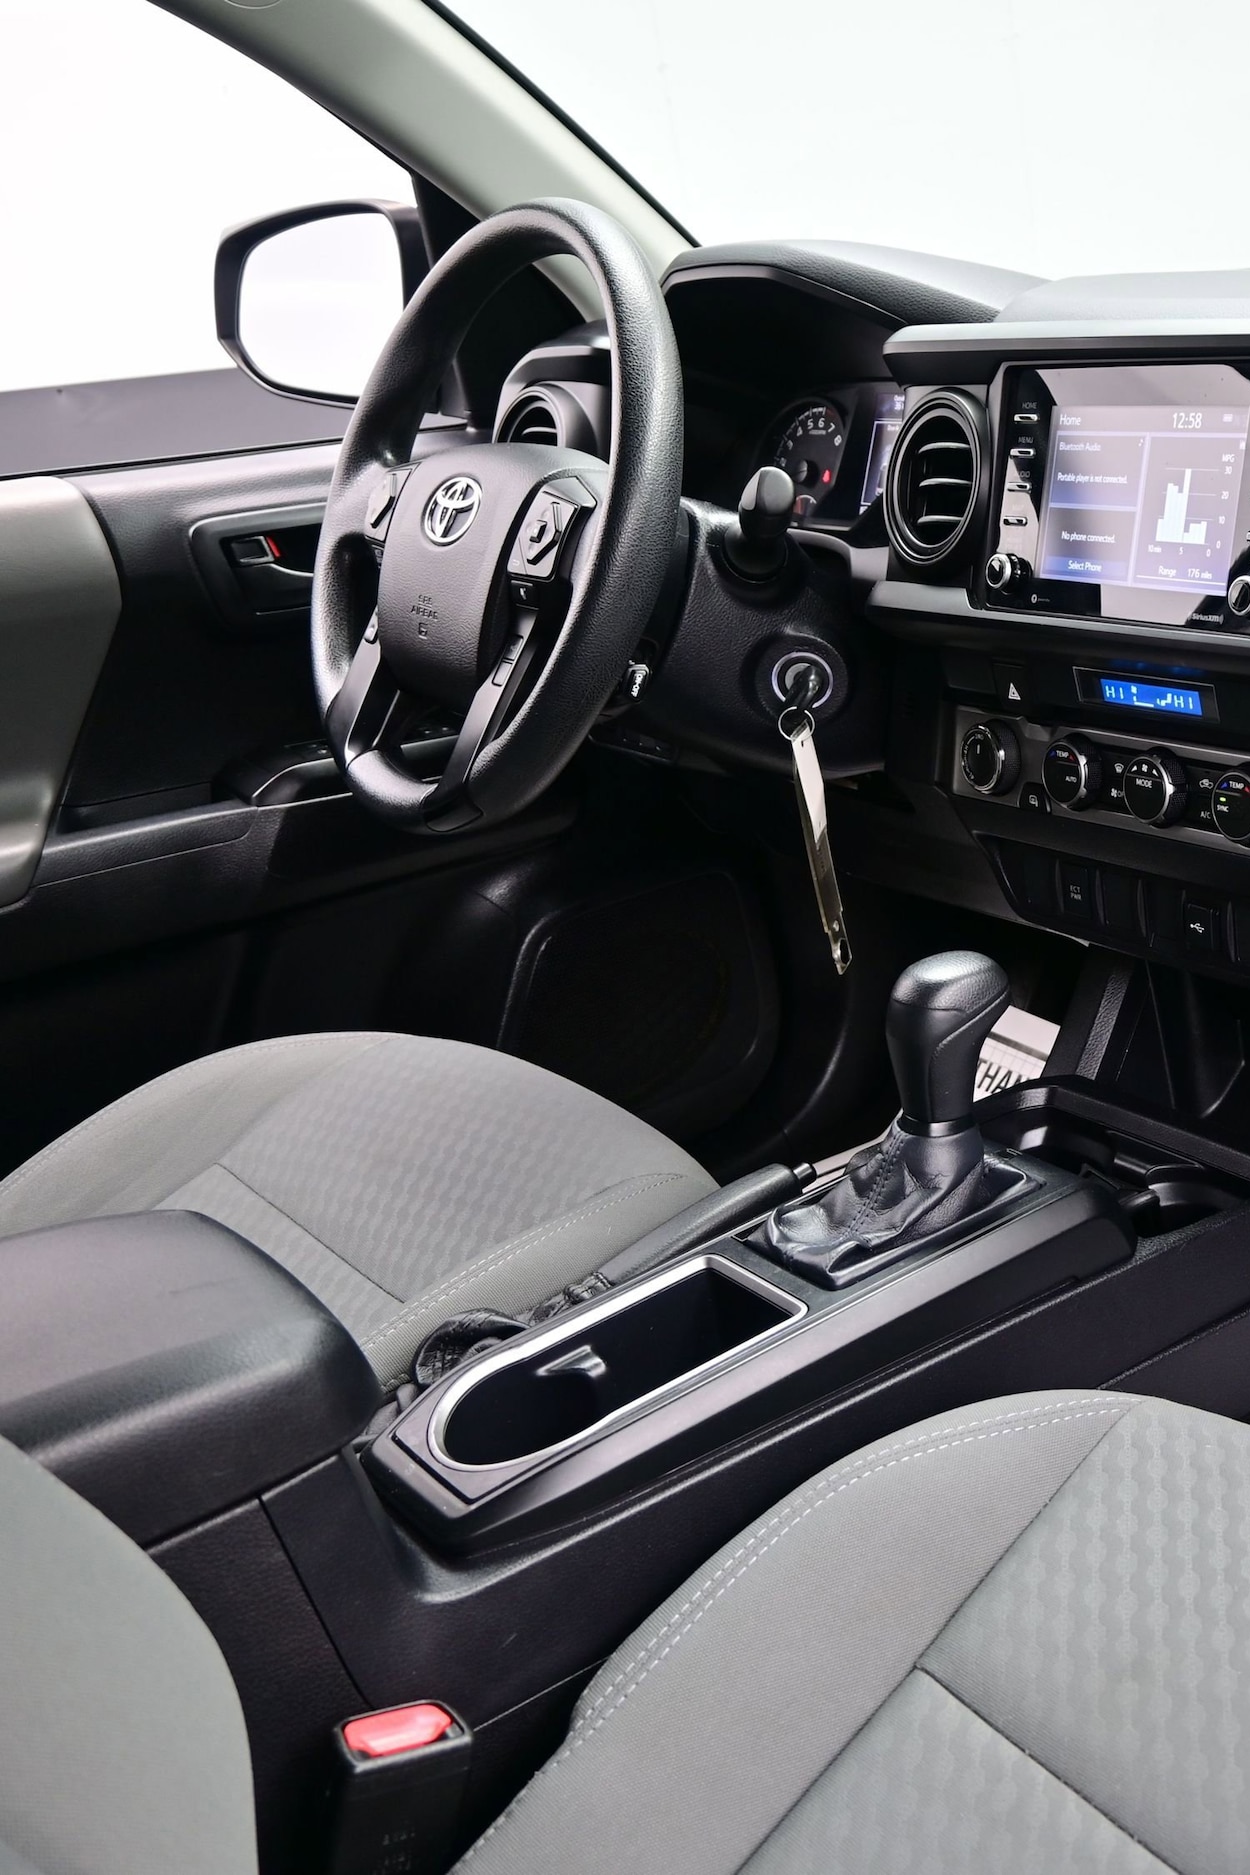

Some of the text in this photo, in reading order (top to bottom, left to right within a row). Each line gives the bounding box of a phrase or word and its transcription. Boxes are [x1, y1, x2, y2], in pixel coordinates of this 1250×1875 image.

[818, 417, 825, 428] 6
[1059, 412, 1202, 429] Home 12:58
[834, 434, 842, 447] 8
[1222, 453, 1235, 463] MPG
[1224, 466, 1233, 475] 30
[1057, 471, 1076, 482] Portable
[1221, 490, 1229, 500] 20
[1061, 530, 1070, 541] No
[1069, 531, 1087, 542] phone
[1067, 560, 1102, 572] Select Phone
[1158, 565, 1177, 577] Range
[1187, 568, 1200, 578] 176
[1056, 750, 1069, 759] TEMP
[1065, 775, 1077, 783] AUTO
[1135, 778, 1153, 789] MODE
[1229, 780, 1244, 790] TEMP
[1200, 810, 1211, 819] A/C
